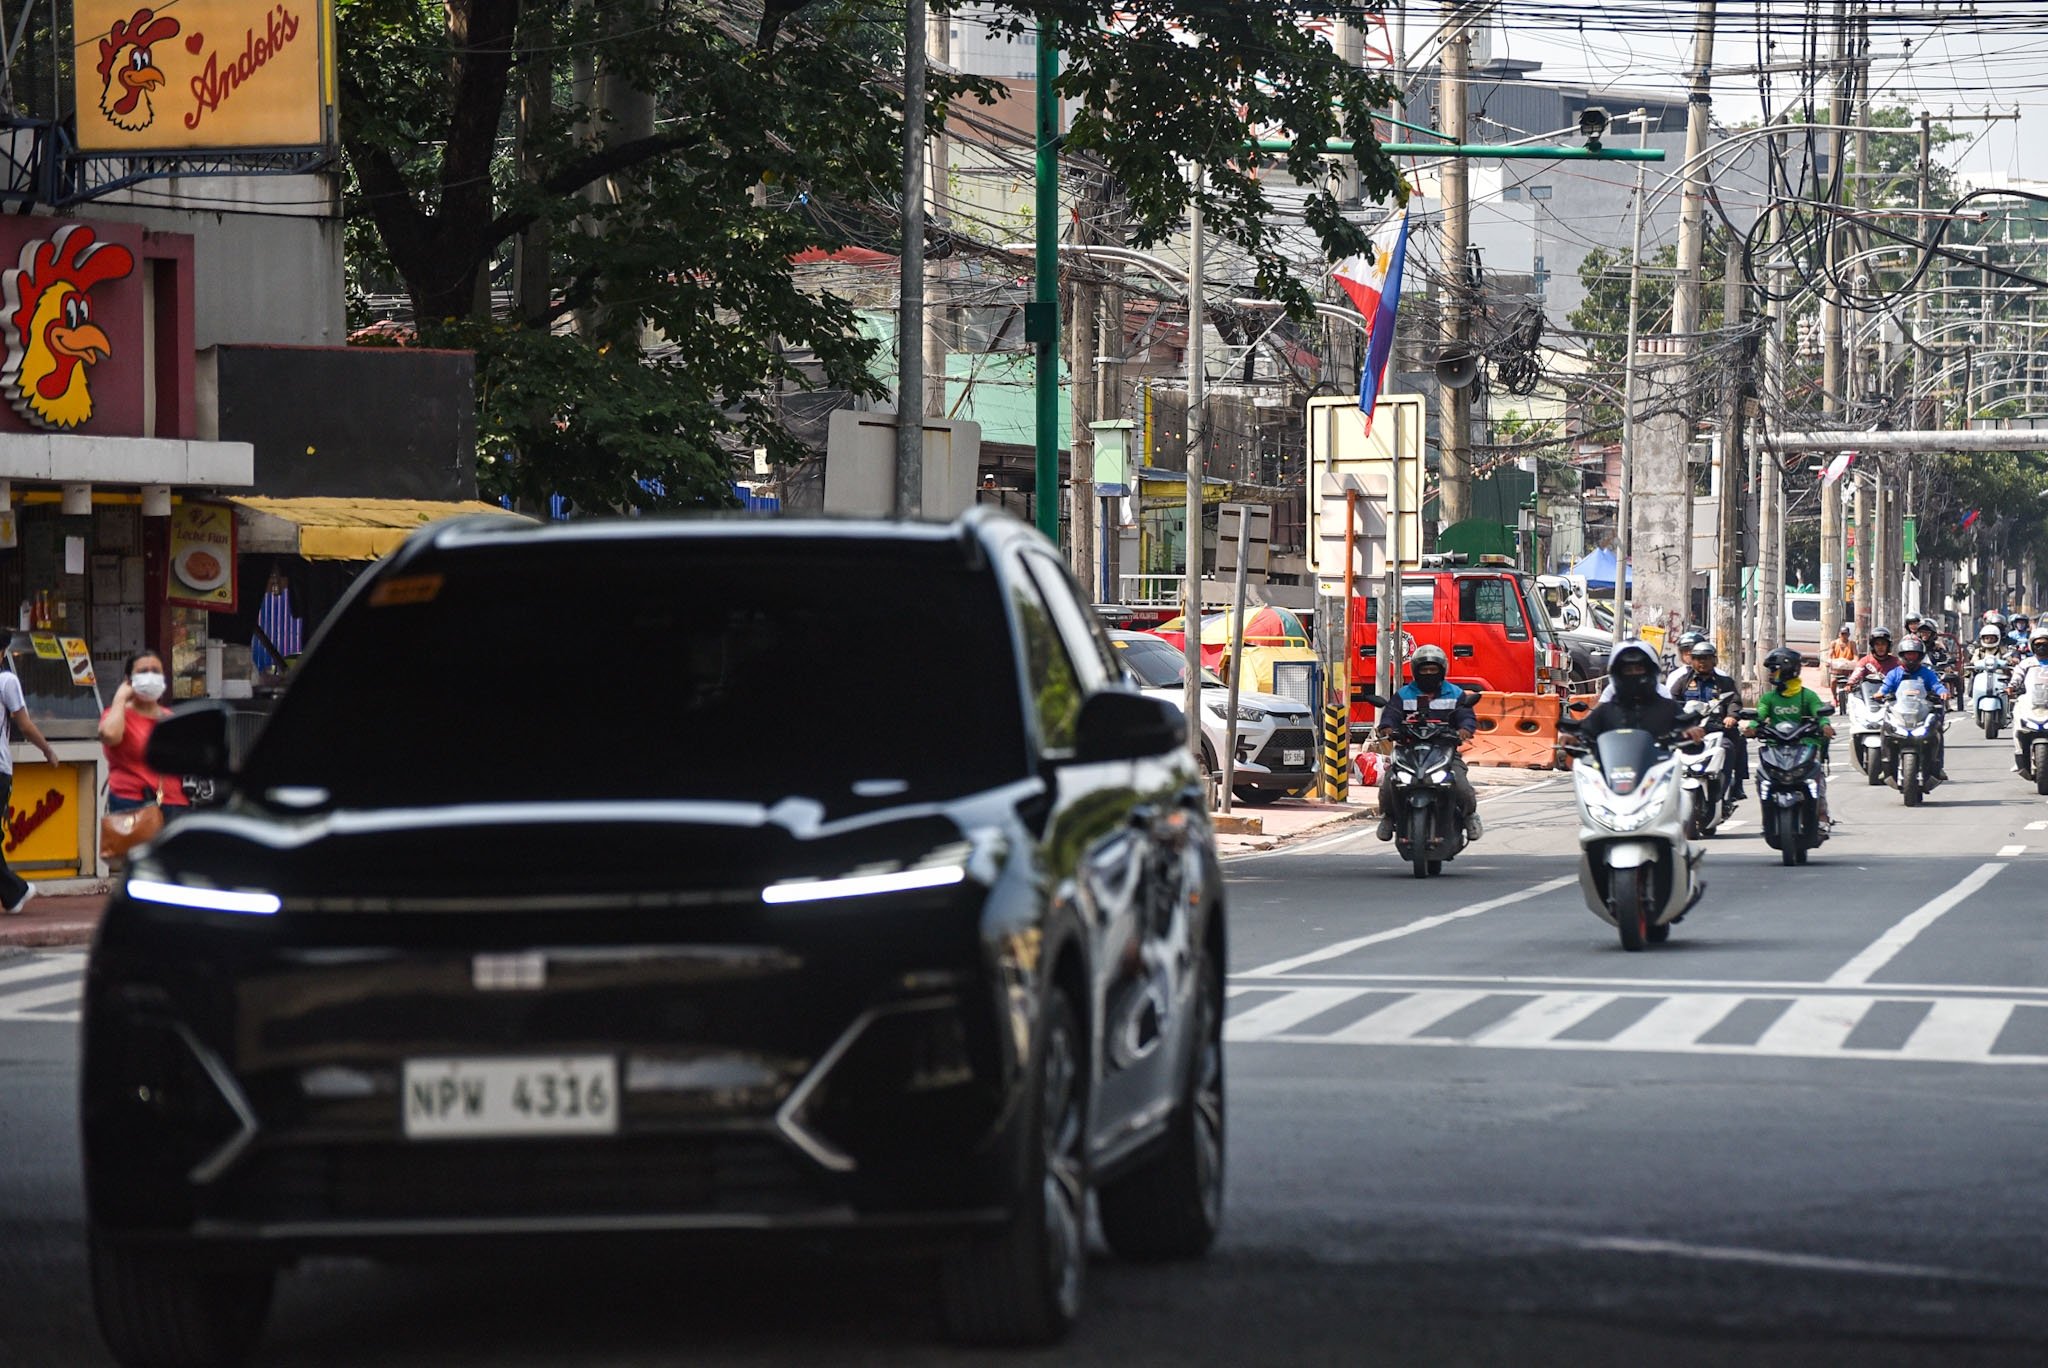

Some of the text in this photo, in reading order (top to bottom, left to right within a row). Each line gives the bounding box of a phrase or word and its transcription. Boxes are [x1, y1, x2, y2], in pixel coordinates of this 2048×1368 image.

[184, 4, 299, 130] Andok's
[177, 527, 205, 541] Leche
[1774, 705, 1799, 715] Grab
[412, 1072, 609, 1122] NPW 4316
